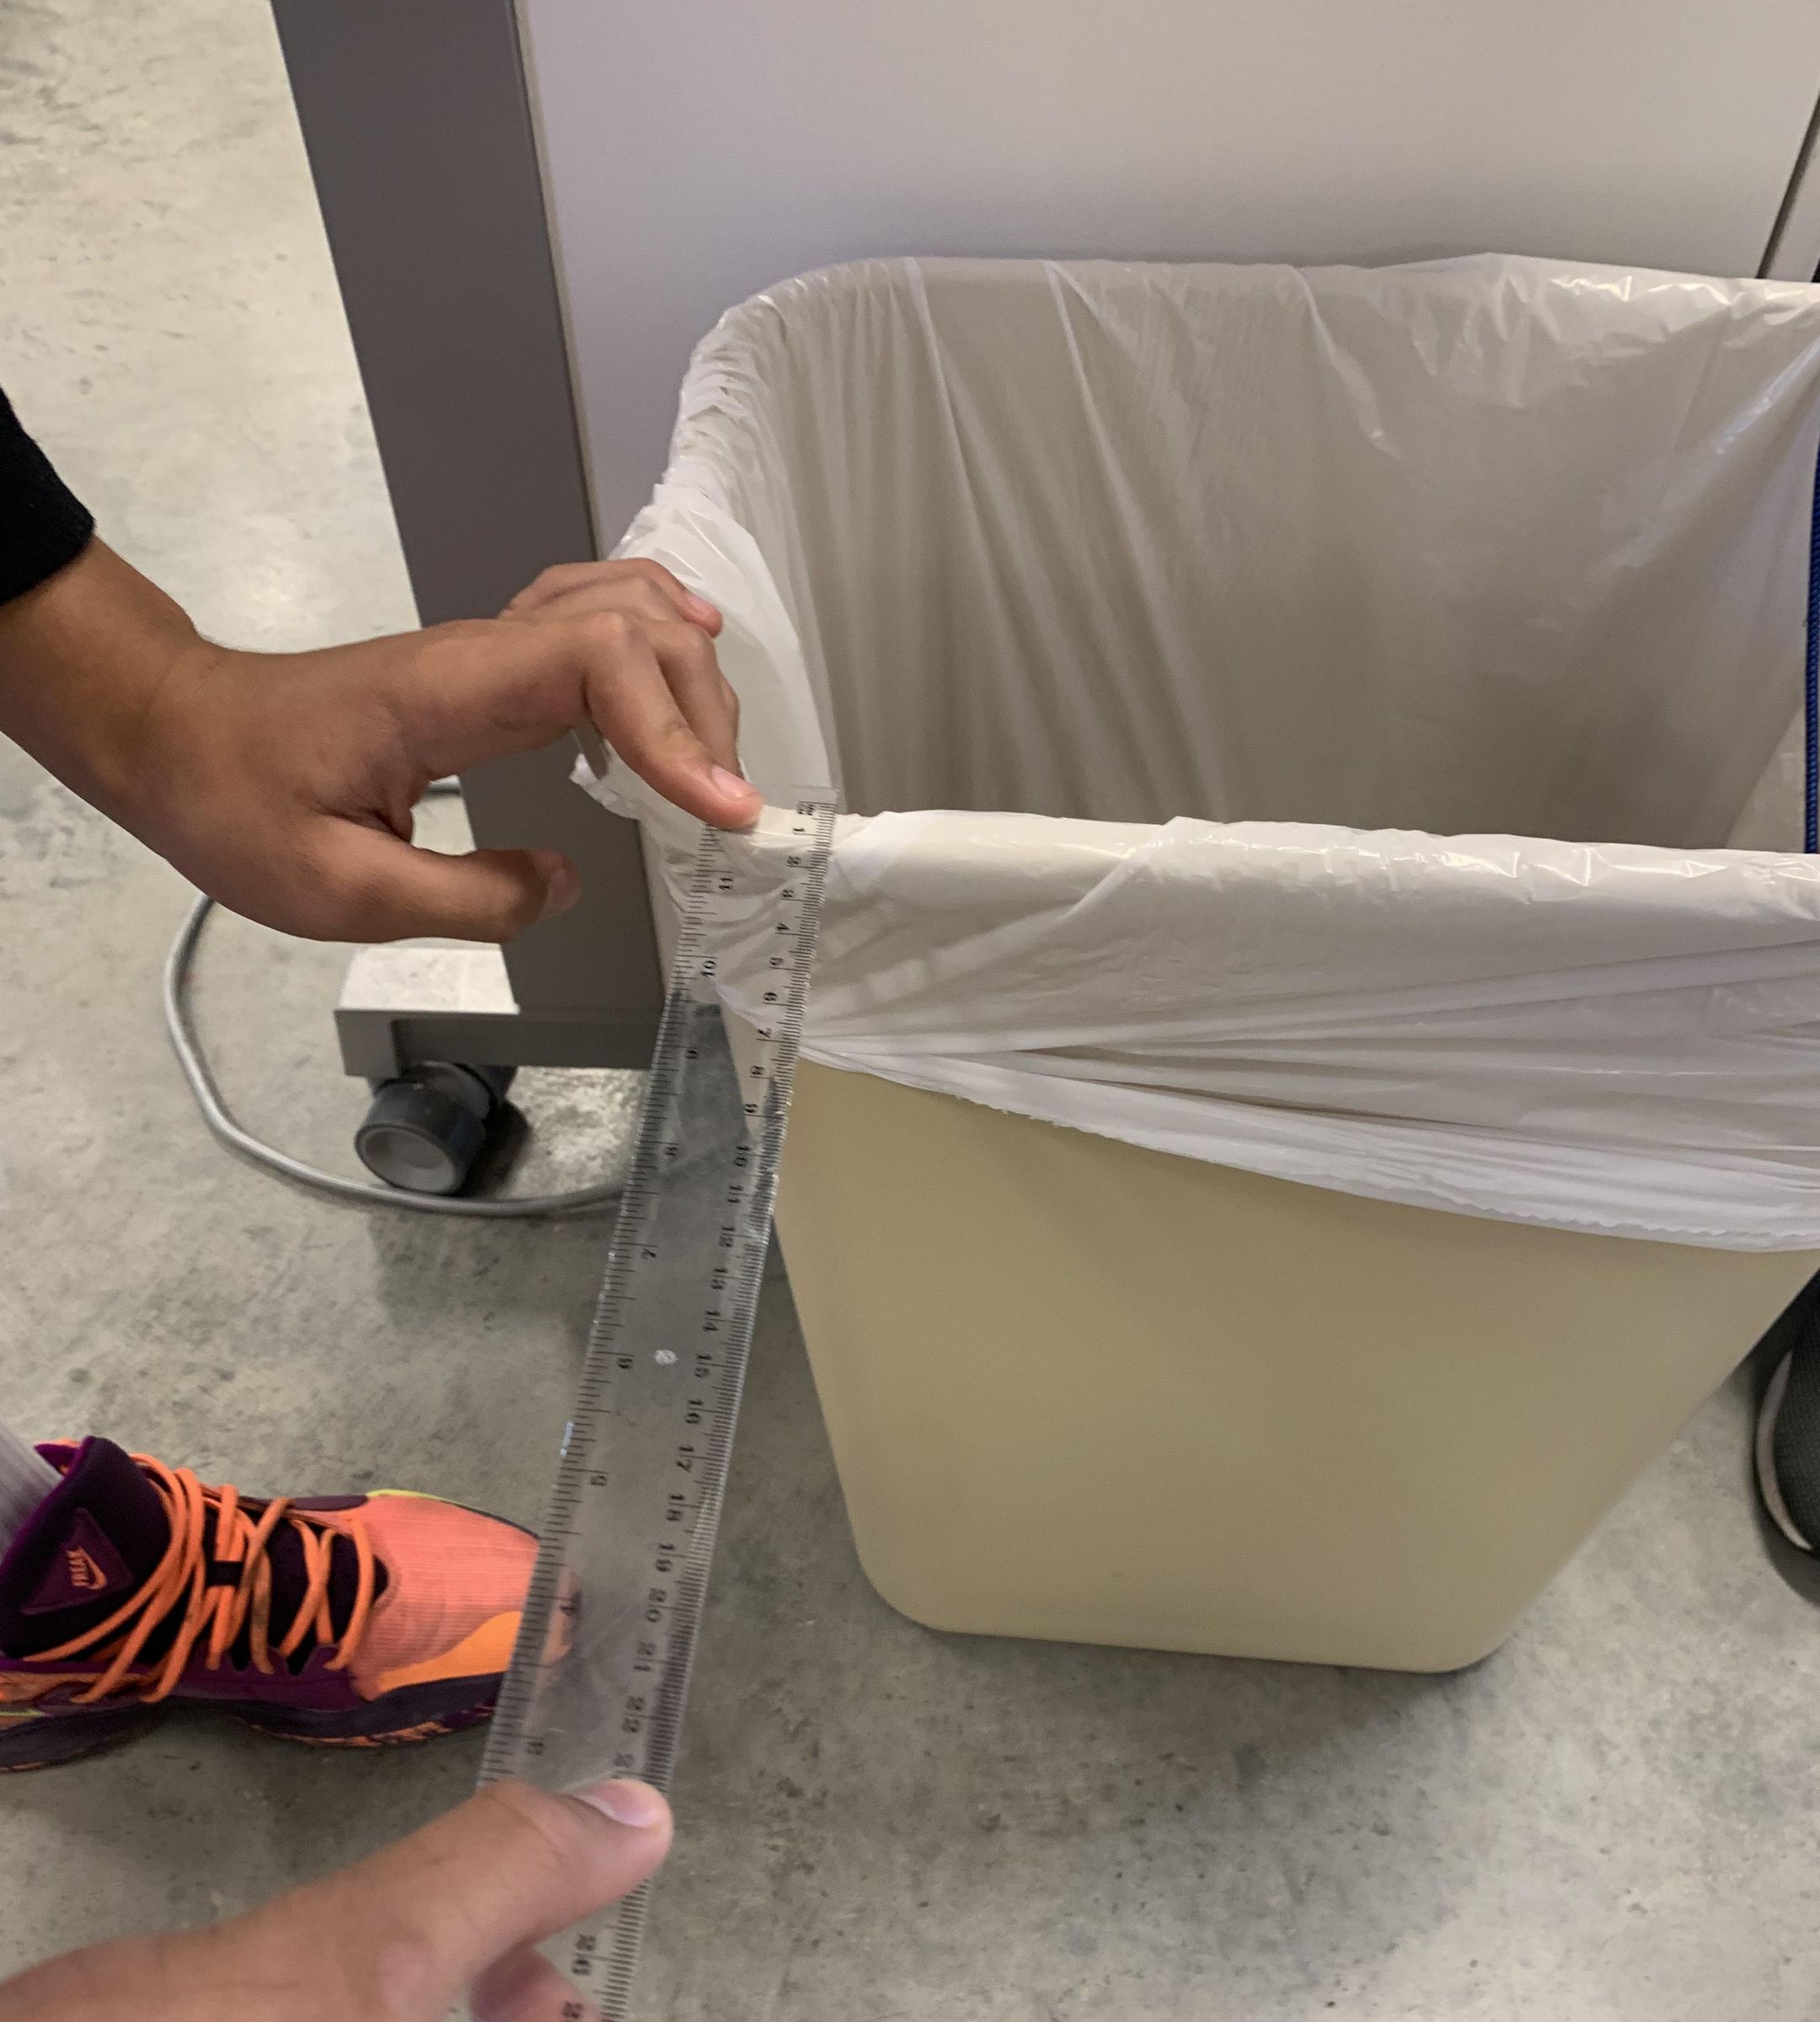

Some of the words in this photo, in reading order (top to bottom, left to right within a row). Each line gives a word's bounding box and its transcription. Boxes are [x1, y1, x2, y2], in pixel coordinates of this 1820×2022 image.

[786, 855, 801, 865] 2
[781, 889, 795, 898] 3
[776, 923, 790, 931] 4
[763, 991, 778, 1002] 6
[757, 1027, 772, 1038] 7
[750, 1065, 765, 1076] 8
[744, 1103, 758, 1114] 9
[617, 1357, 633, 1369] 6
[640, 1249, 657, 1260] 7
[700, 960, 718, 977] 10
[718, 877, 733, 891] 11
[733, 1145, 751, 1168] 10
[727, 1185, 743, 1203] 11
[718, 1225, 736, 1248] 12
[710, 1267, 728, 1290] 13
[702, 1310, 720, 1332] 14
[694, 1354, 712, 1378] 15
[685, 1399, 704, 1424] 16
[676, 1445, 693, 1473] 17
[665, 1492, 684, 1522] 18
[655, 1543, 675, 1573] 19
[645, 1587, 666, 1623] 20
[634, 1641, 656, 1672] 21
[621, 1695, 645, 1733] 22
